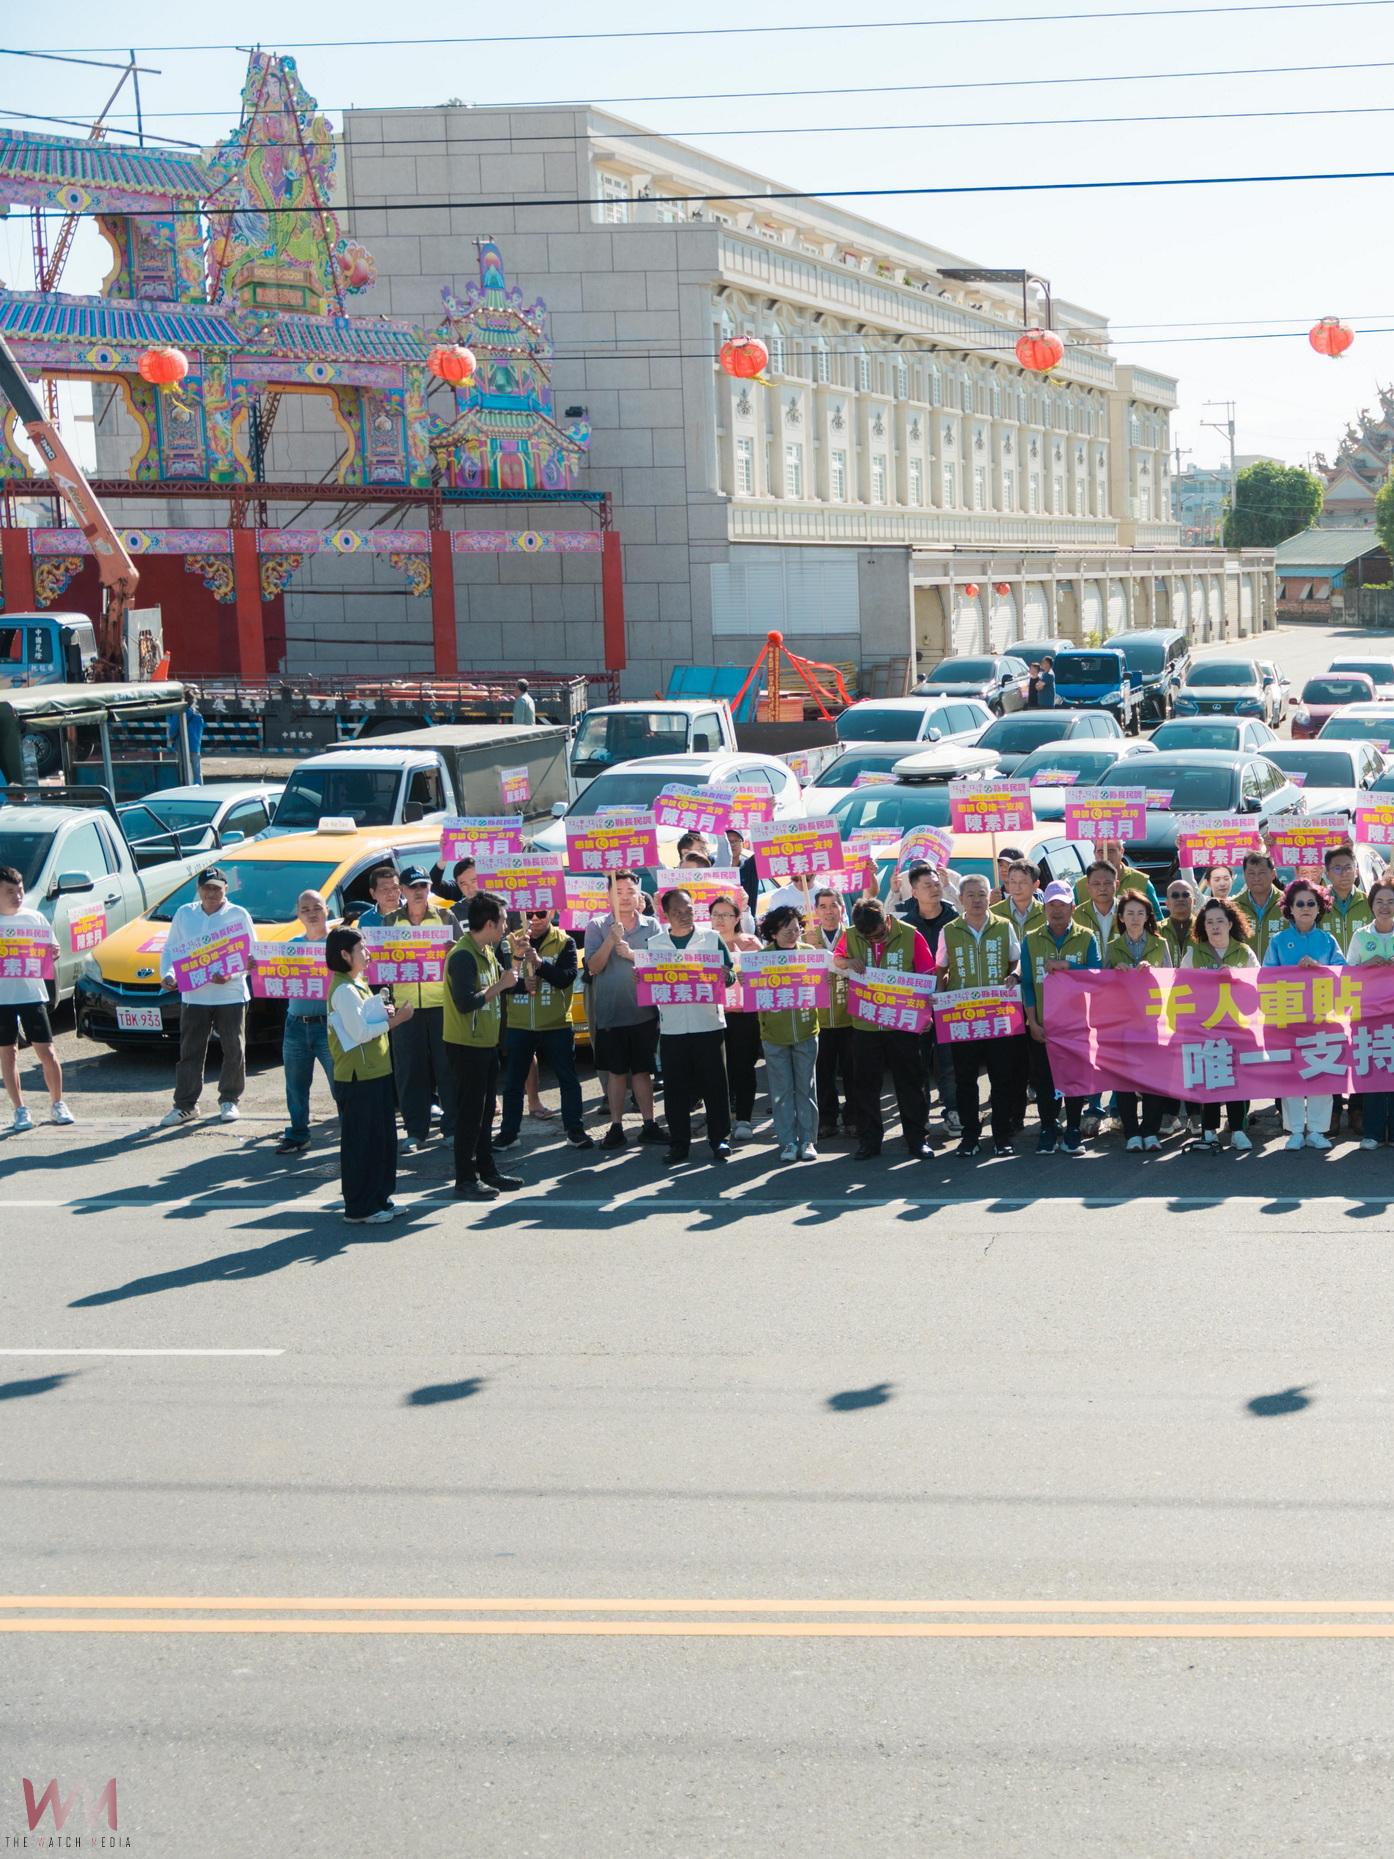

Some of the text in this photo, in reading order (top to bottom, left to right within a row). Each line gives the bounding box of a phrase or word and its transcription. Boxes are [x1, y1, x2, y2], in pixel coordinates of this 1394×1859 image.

[663, 806, 714, 830] 陳素月
[729, 811, 762, 828] 素月
[964, 812, 1021, 831] 陳素月
[1078, 820, 1133, 837] 陳素月
[582, 847, 644, 869] 陳素月
[768, 851, 830, 875] 陳素月
[1282, 844, 1325, 864] 陳素
[296, 946, 325, 956] 縣長民
[2, 958, 43, 977] 素月
[378, 961, 439, 981] 陳素月
[264, 977, 324, 997] 陳素月
[652, 983, 713, 1002] 陳素月
[755, 986, 815, 1007] 陳素月
[1146, 977, 1362, 1033] 千人車貼
[860, 1001, 917, 1030] 陳素月
[949, 1016, 1011, 1039] 陳素月
